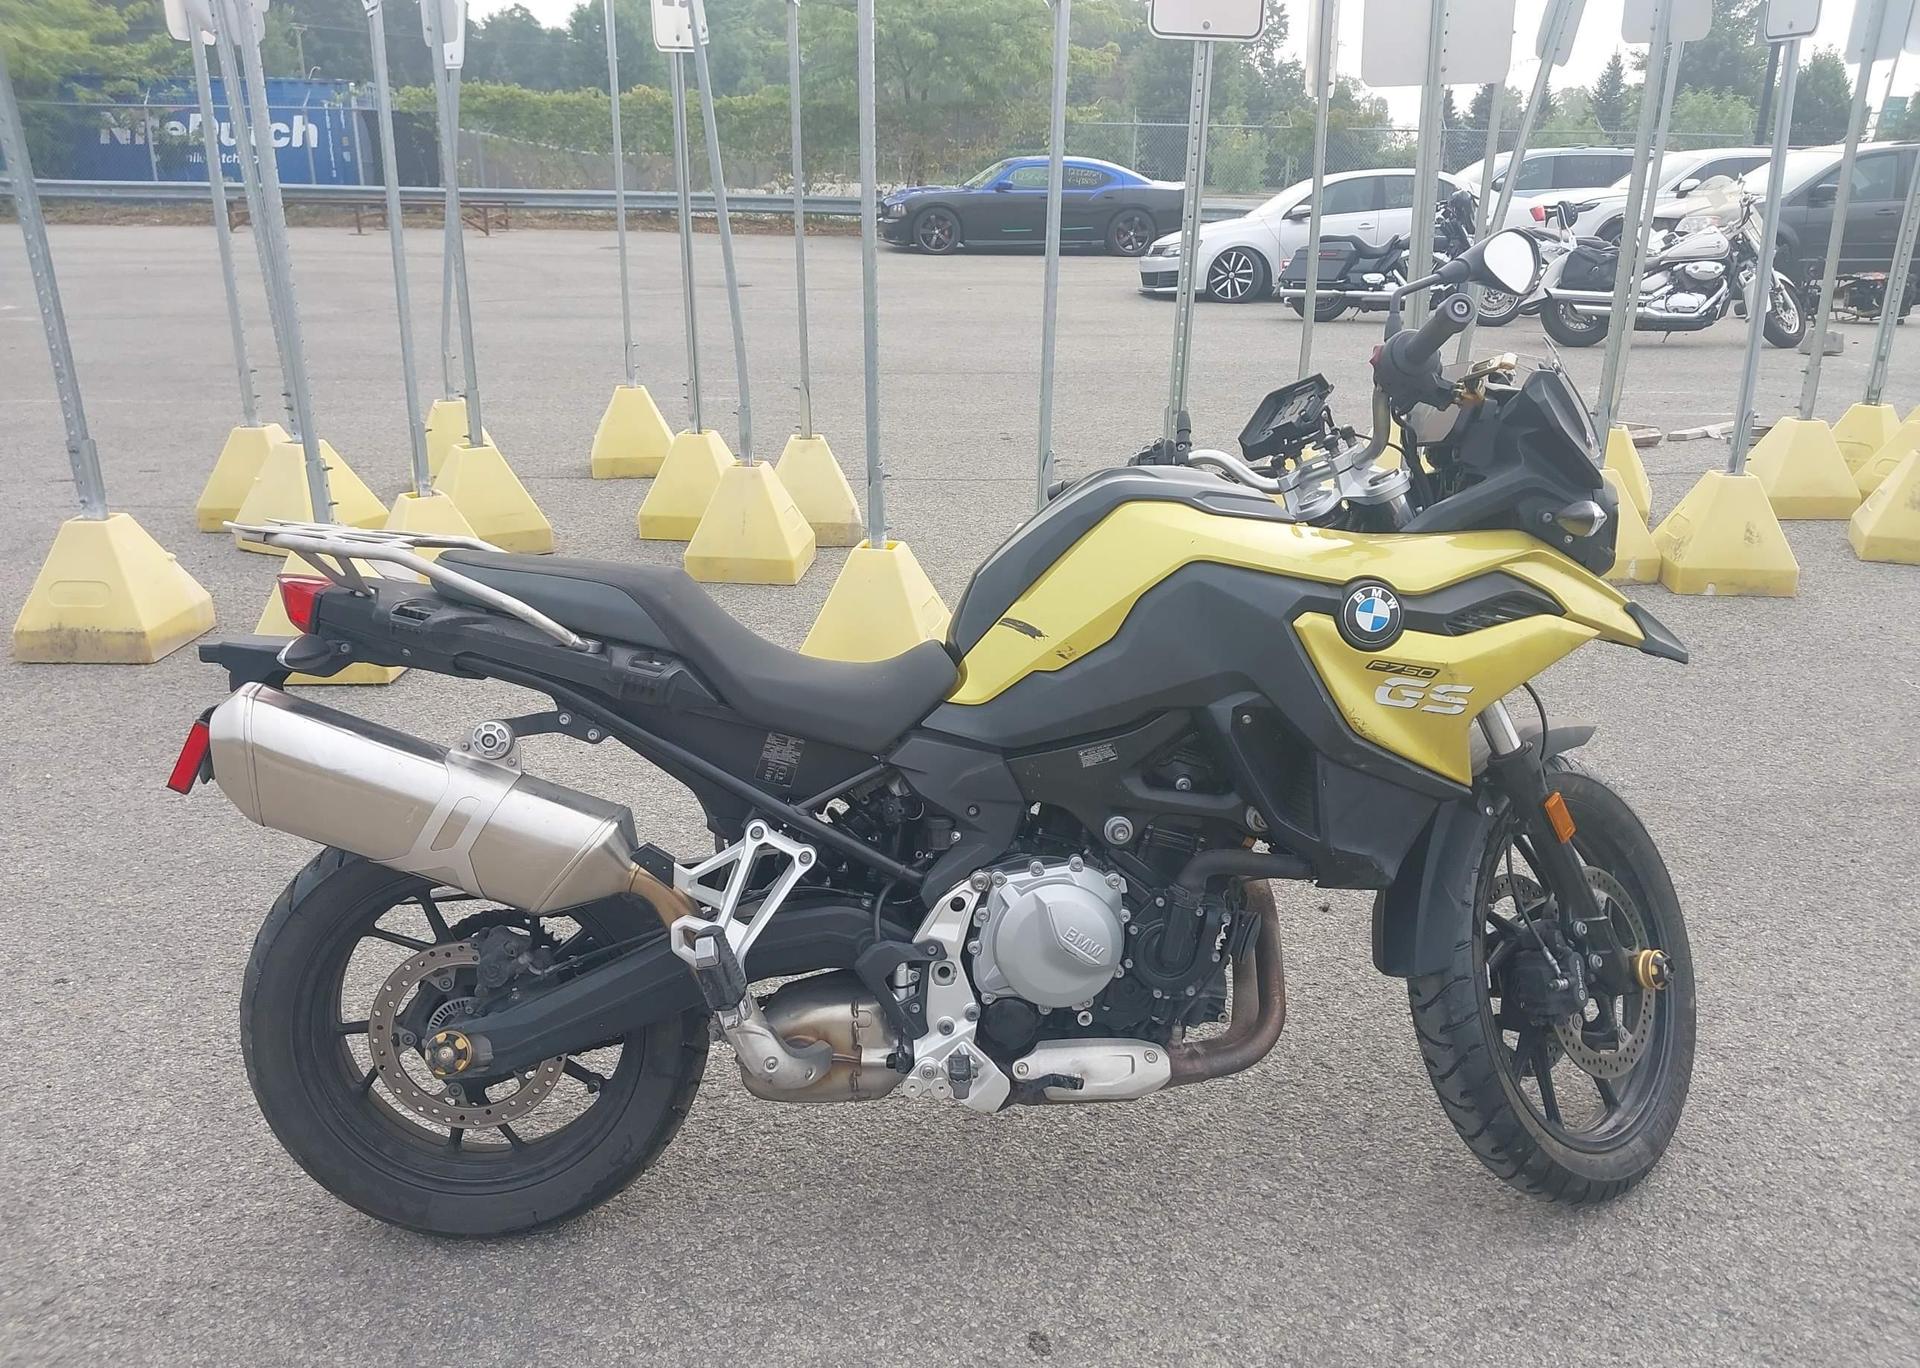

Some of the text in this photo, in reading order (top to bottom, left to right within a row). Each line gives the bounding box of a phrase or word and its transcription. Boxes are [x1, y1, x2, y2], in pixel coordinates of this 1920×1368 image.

[1353, 588, 1398, 610] BMW
[1368, 661, 1437, 678] F750
[1374, 677, 1475, 715] GS
[1064, 926, 1104, 956] BMW
